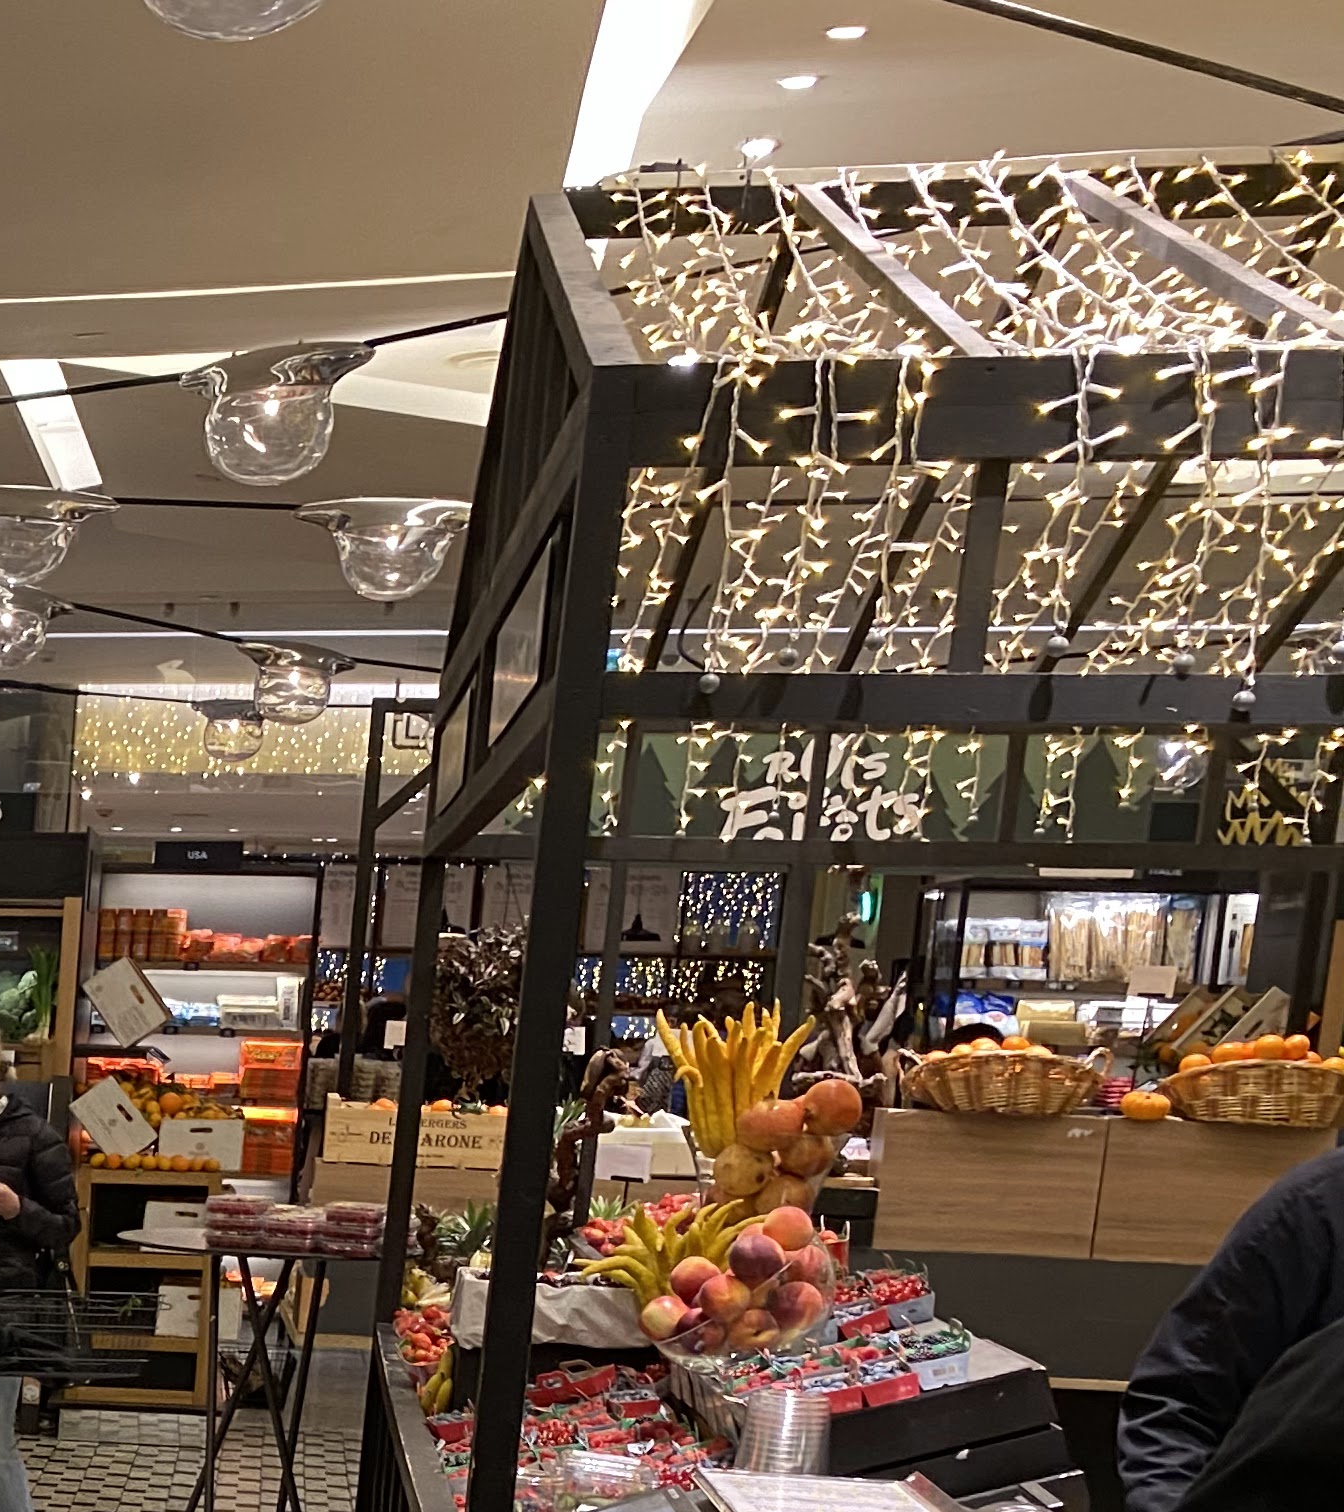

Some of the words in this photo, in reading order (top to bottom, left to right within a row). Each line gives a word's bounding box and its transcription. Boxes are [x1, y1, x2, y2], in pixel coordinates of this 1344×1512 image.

[187, 851, 208, 860] USA
[421, 1119, 467, 1130] ERGERS
[369, 1131, 392, 1145] DE
[420, 1134, 483, 1149] ARONE
